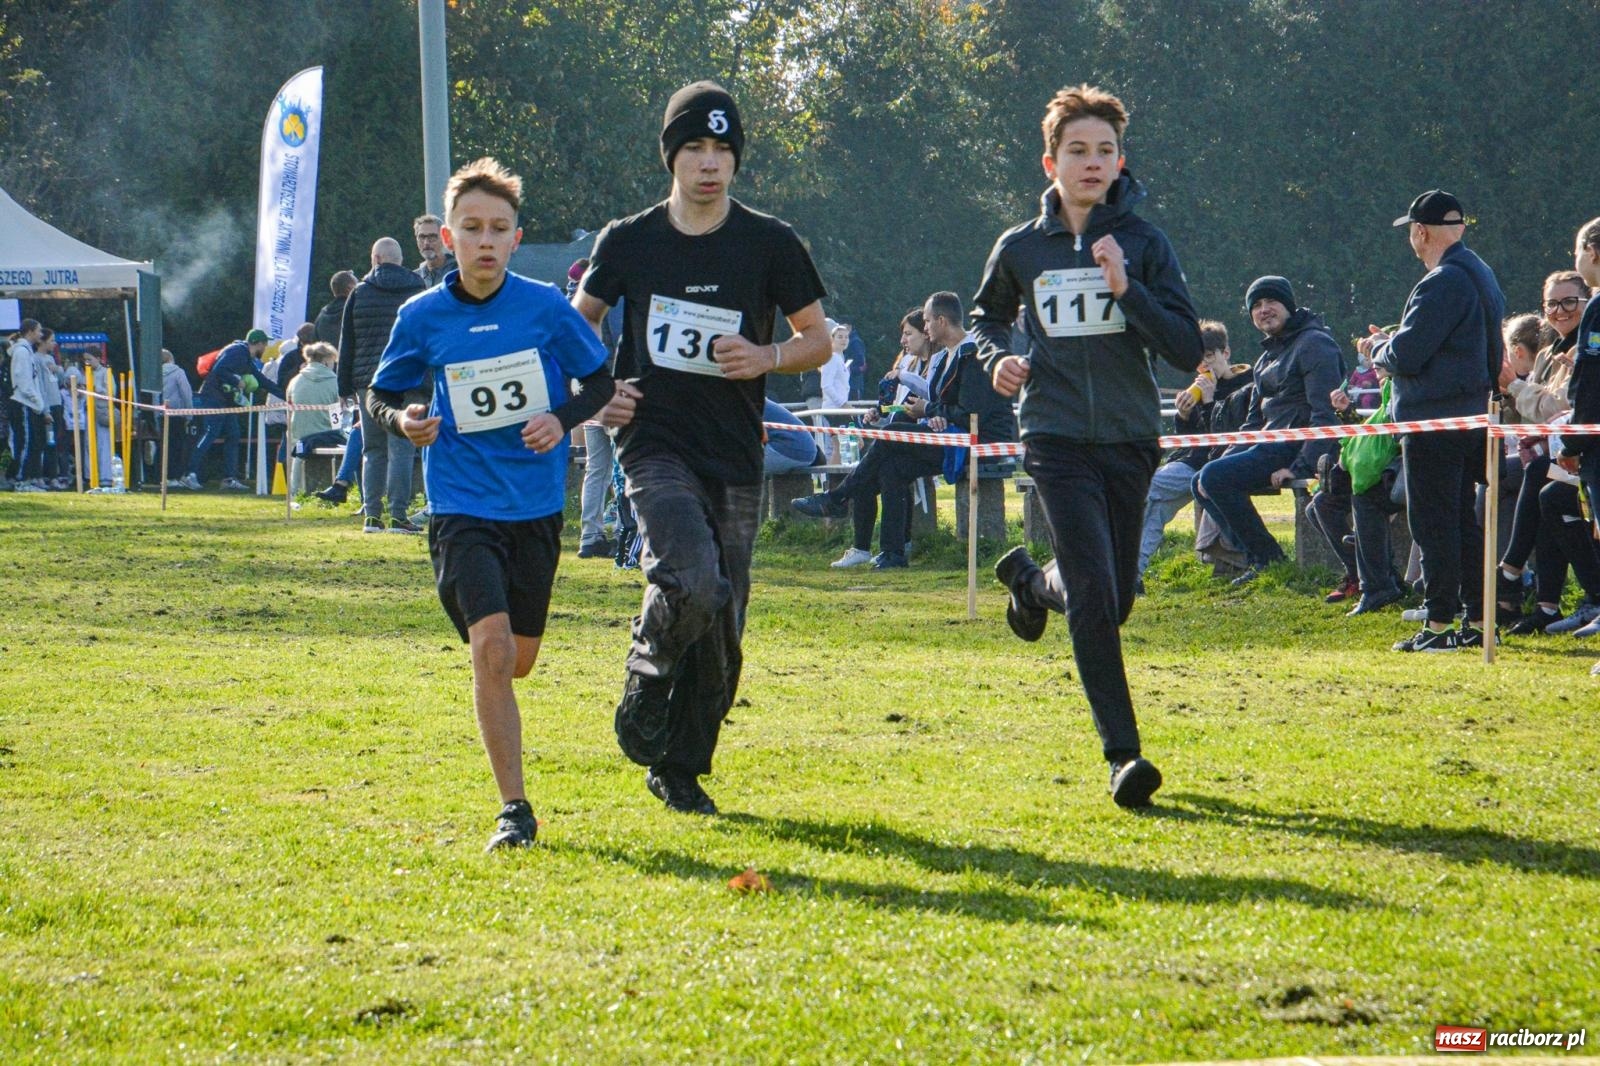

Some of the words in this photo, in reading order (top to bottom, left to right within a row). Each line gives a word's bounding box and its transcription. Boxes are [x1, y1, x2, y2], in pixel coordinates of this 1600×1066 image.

[279, 152, 300, 220] STOWARZYSZENIE
[274, 220, 293, 255] AKTYWNI
[43, 269, 79, 285] JUTRA
[1042, 291, 1116, 325] 117
[270, 314, 284, 340] JUTRA
[470, 380, 528, 418] 93
